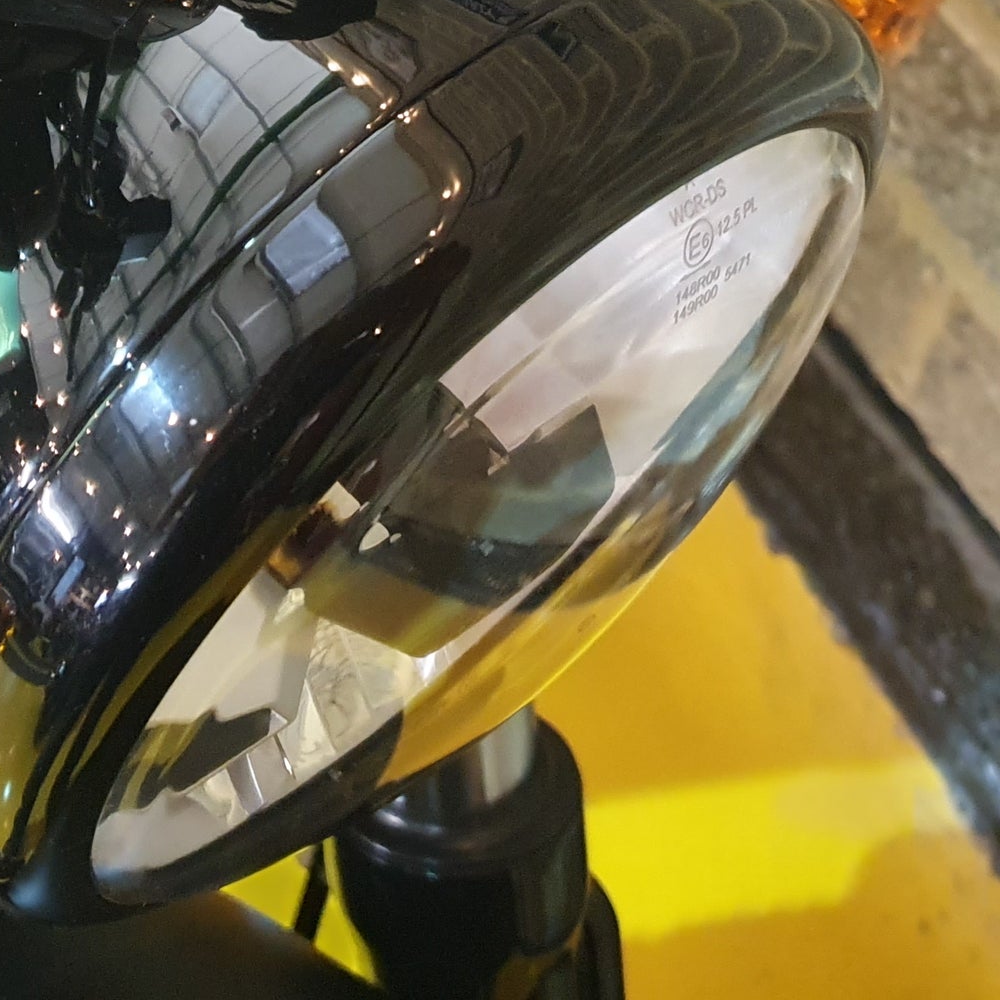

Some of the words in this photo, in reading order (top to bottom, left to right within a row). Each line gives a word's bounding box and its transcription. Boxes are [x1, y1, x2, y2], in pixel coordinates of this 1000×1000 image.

[676, 265, 721, 306] 148R00
[723, 252, 751, 282] 5471
[673, 283, 719, 325] 149R00
